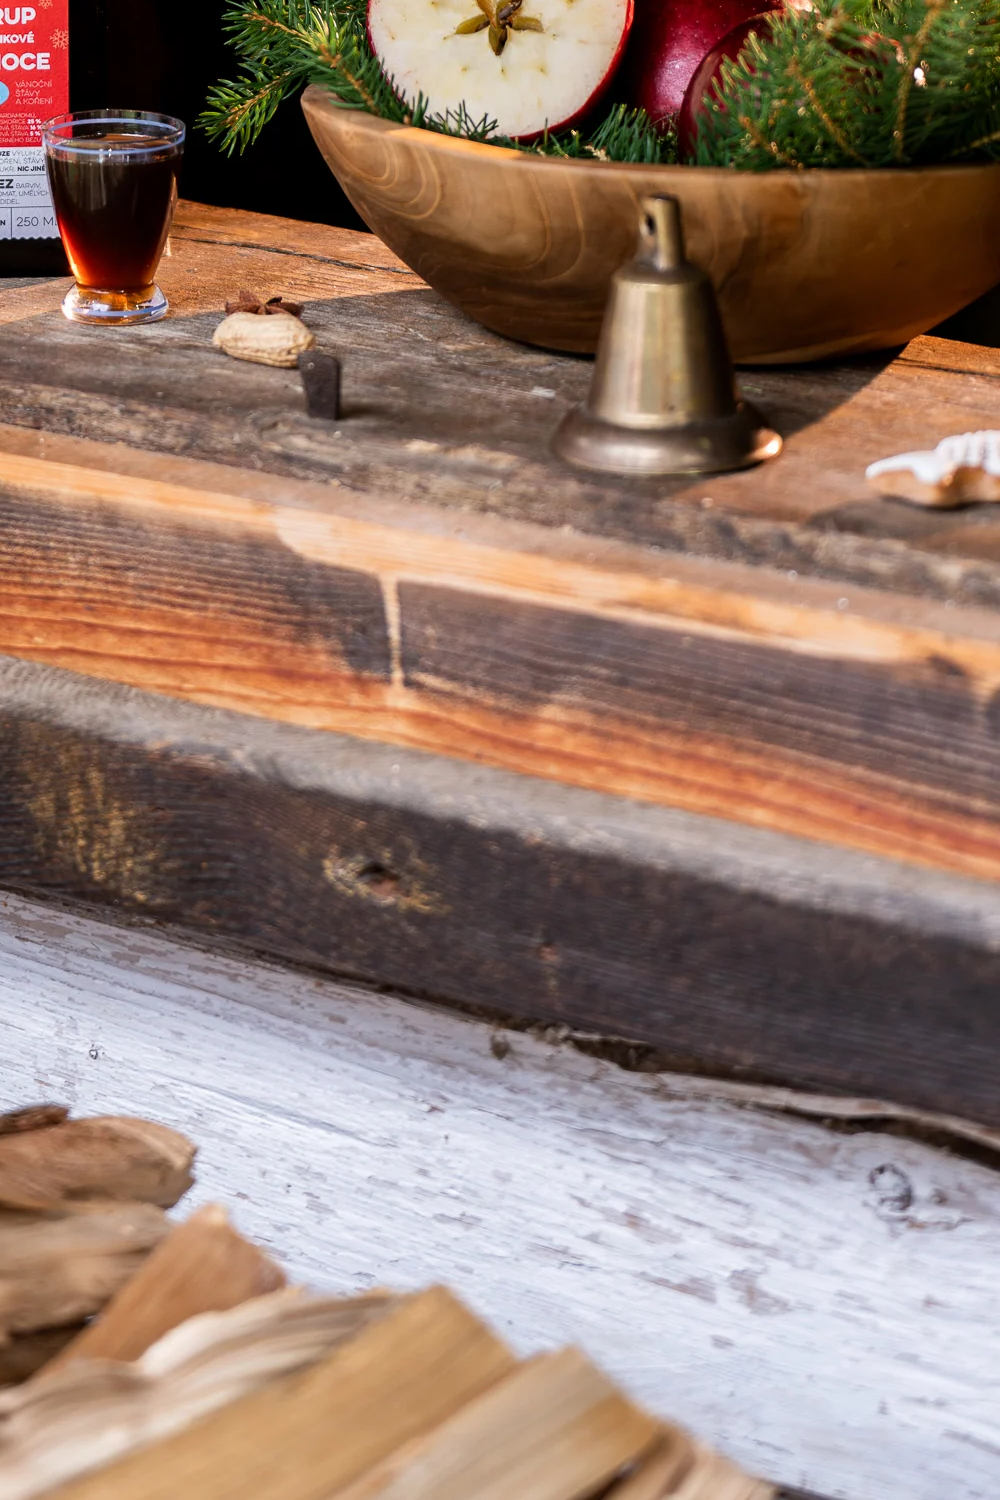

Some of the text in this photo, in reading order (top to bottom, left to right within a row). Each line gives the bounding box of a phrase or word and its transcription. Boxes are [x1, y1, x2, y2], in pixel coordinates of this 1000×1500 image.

[15, 79, 53, 88] VÁNOČNÍ
[15, 89, 40, 97] ŠŤÁVY
[23, 96, 53, 105] KOŘENÍ
[12, 149, 35, 157] VÝLUH
[31, 164, 45, 172] JINÉ
[16, 216, 39, 227] 250
